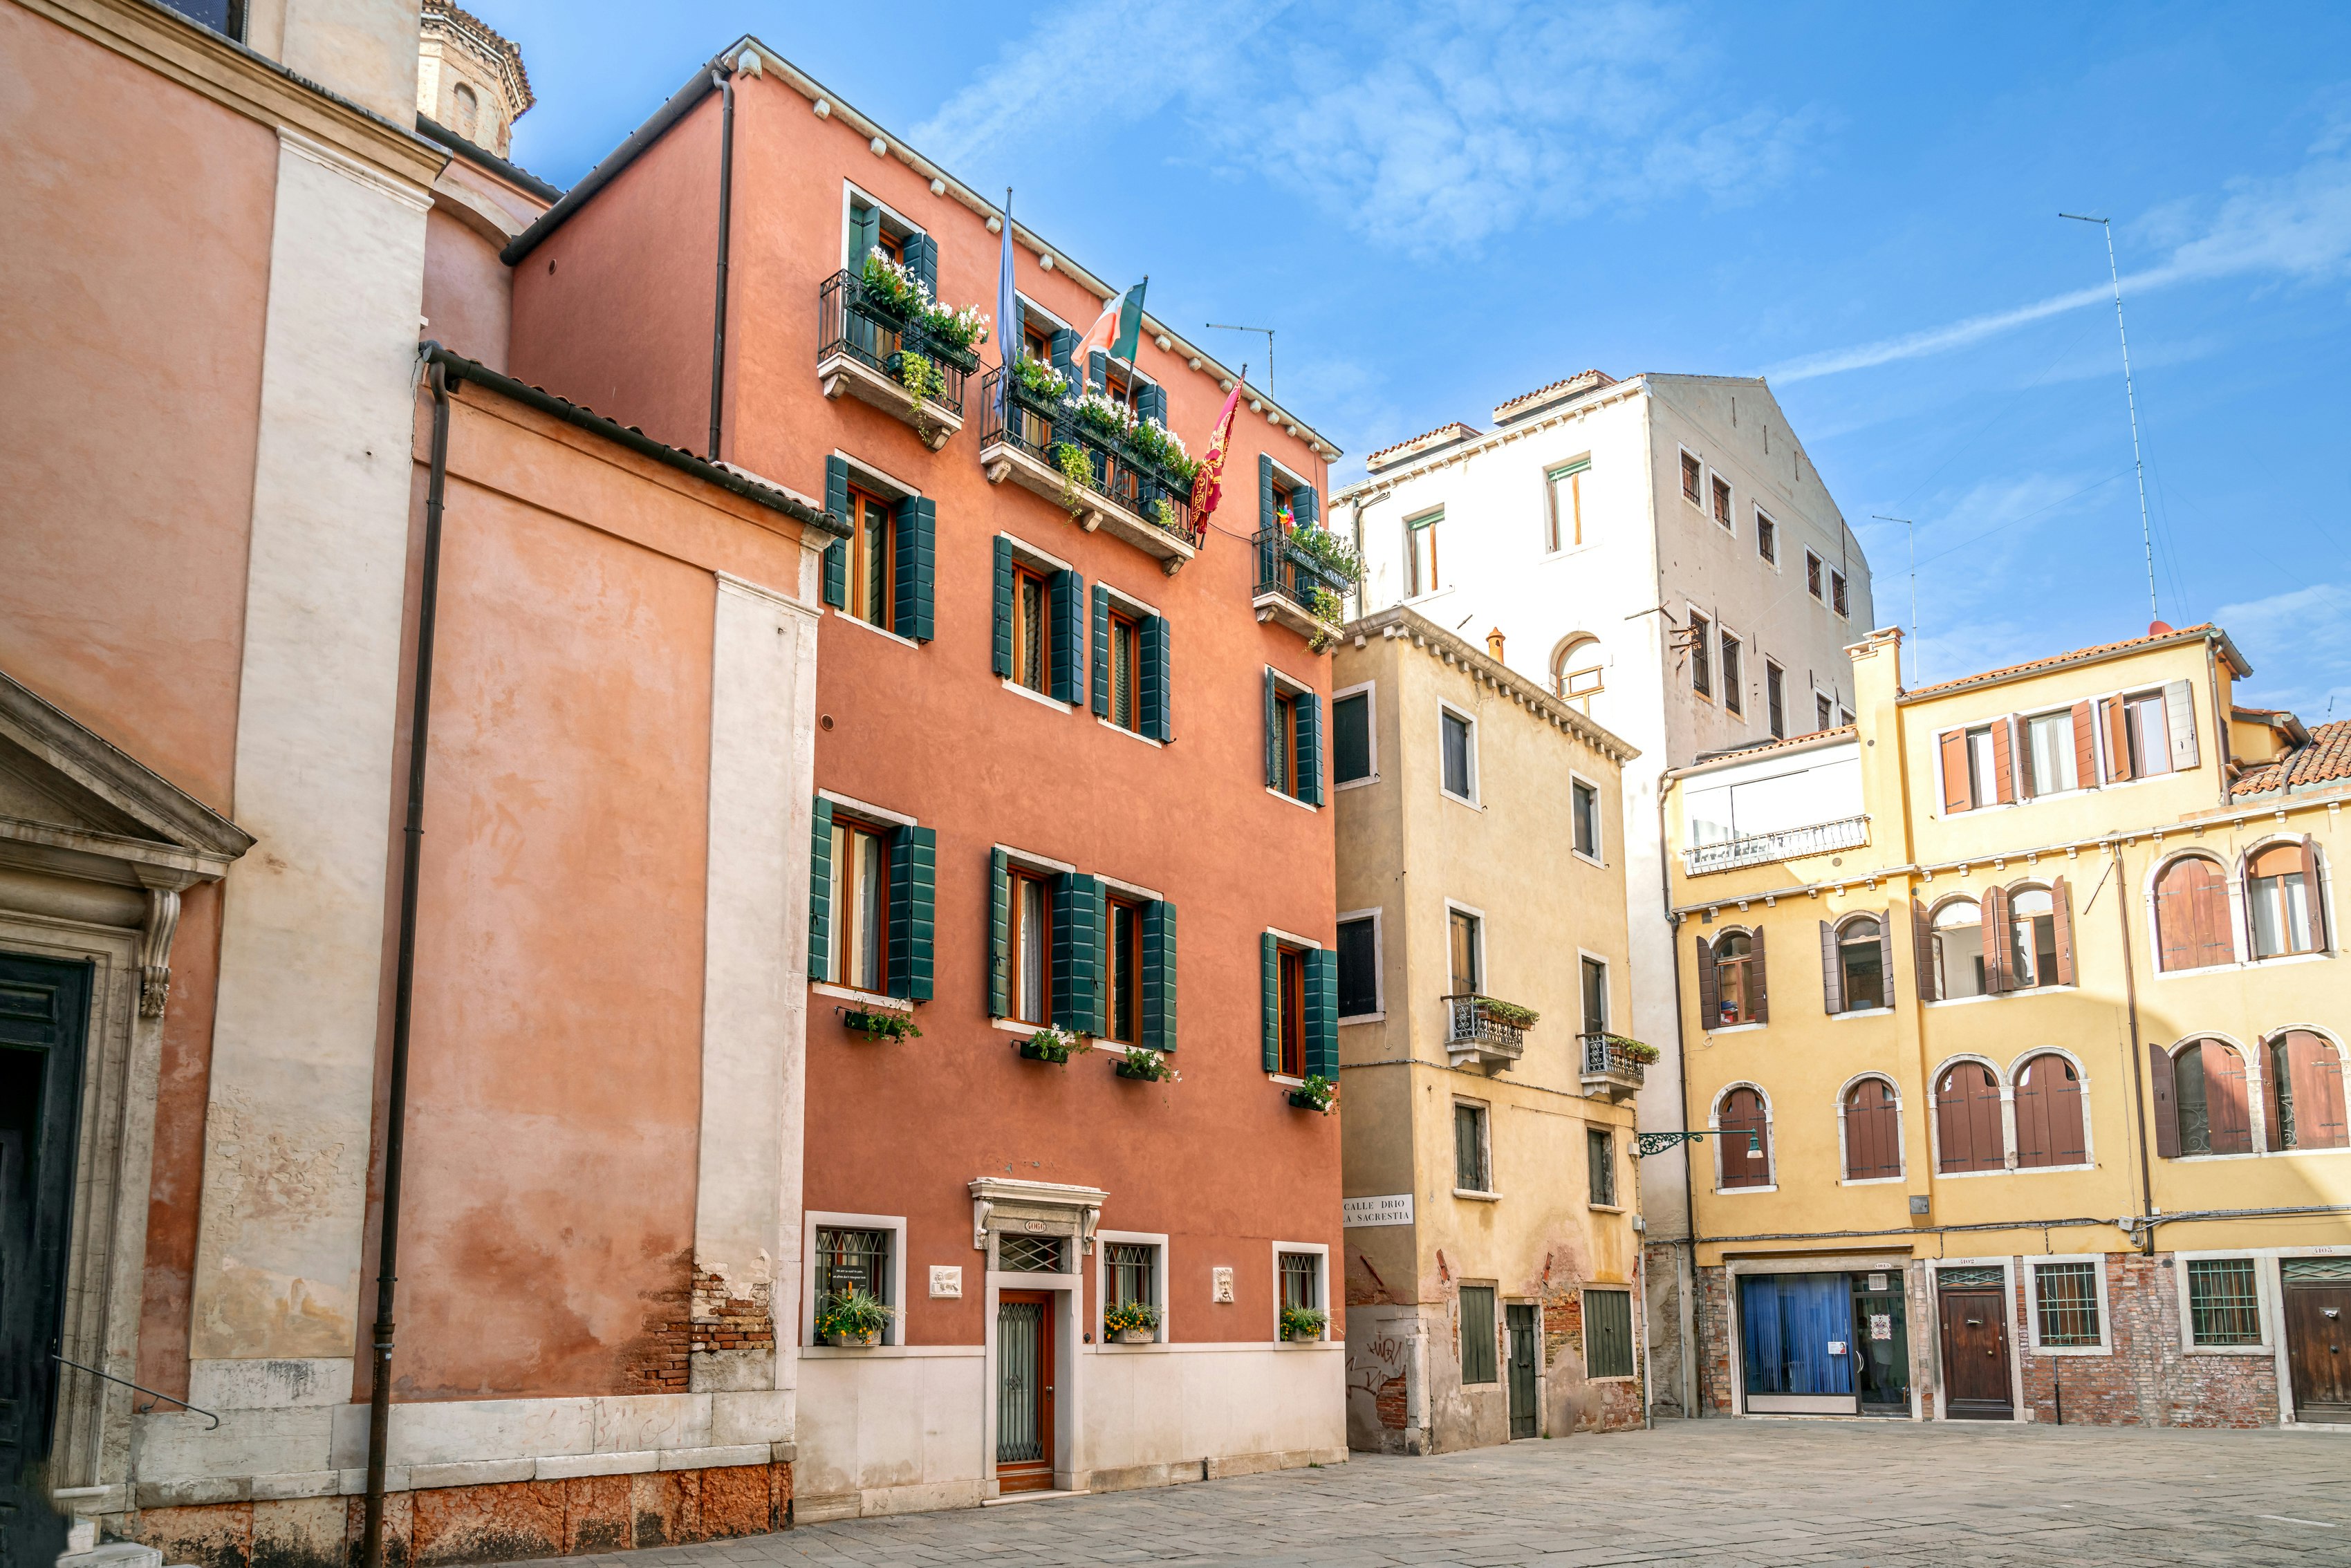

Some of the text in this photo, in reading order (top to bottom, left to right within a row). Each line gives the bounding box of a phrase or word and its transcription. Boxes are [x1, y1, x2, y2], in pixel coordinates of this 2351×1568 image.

[1344, 1200, 1404, 1211] CALLE DRIO
[1357, 1212, 1409, 1222] SACRESTIA
[1028, 1222, 1045, 1230] 4066
